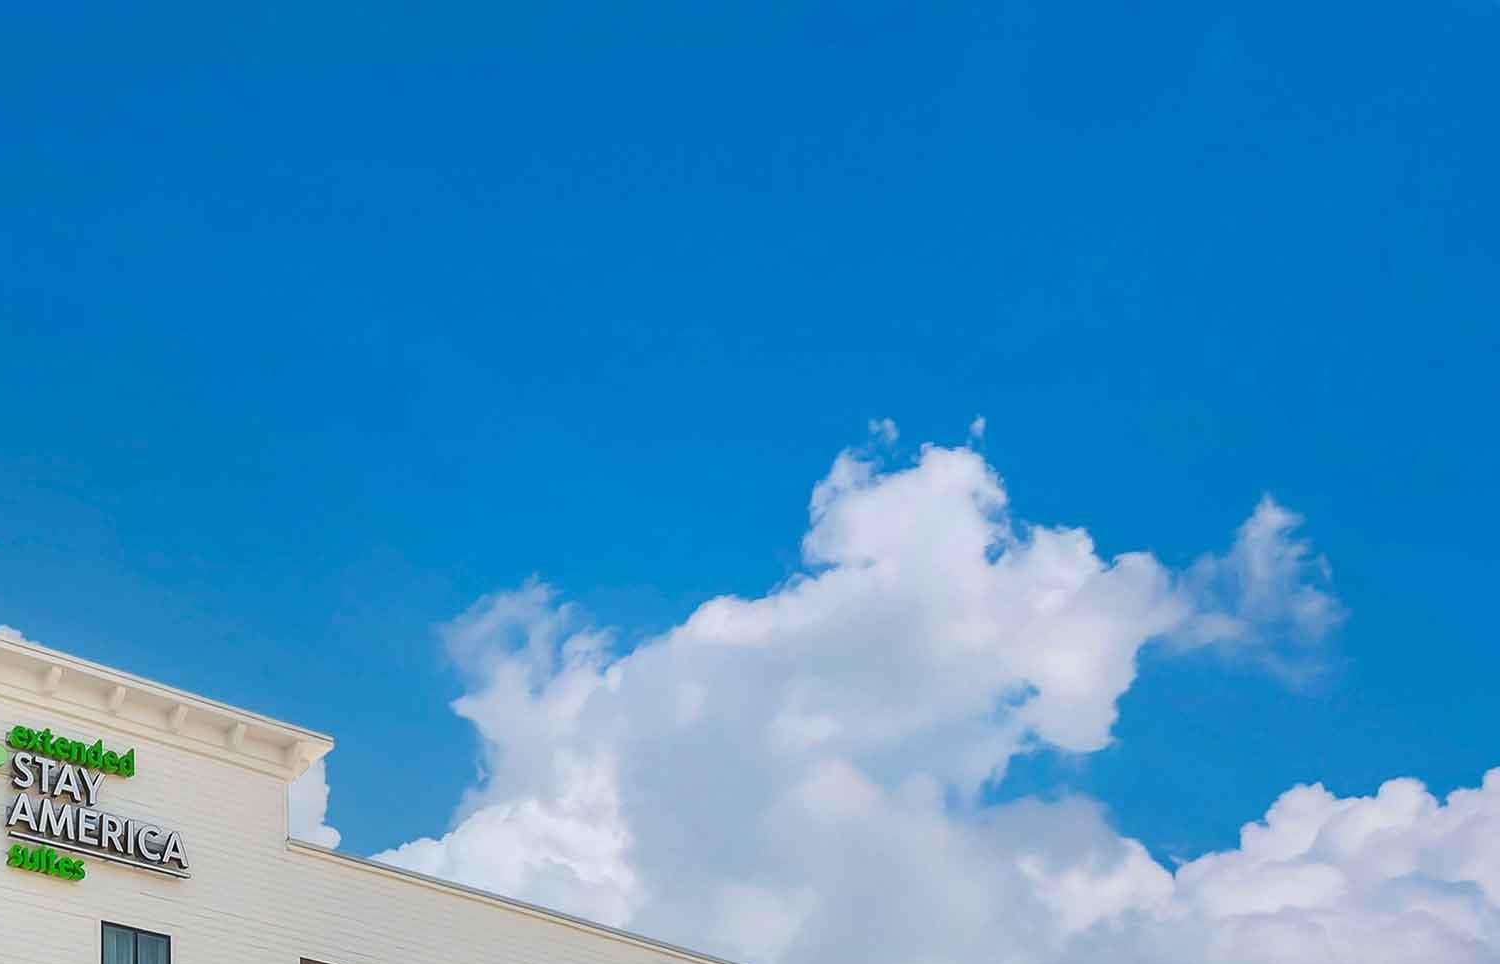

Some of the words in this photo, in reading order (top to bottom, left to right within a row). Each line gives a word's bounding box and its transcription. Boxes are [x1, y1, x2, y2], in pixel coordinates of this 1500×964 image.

[7, 725, 135, 777] extended
[12, 752, 106, 804] STAY
[8, 793, 189, 868] AMERICA
[7, 844, 86, 881] suites
